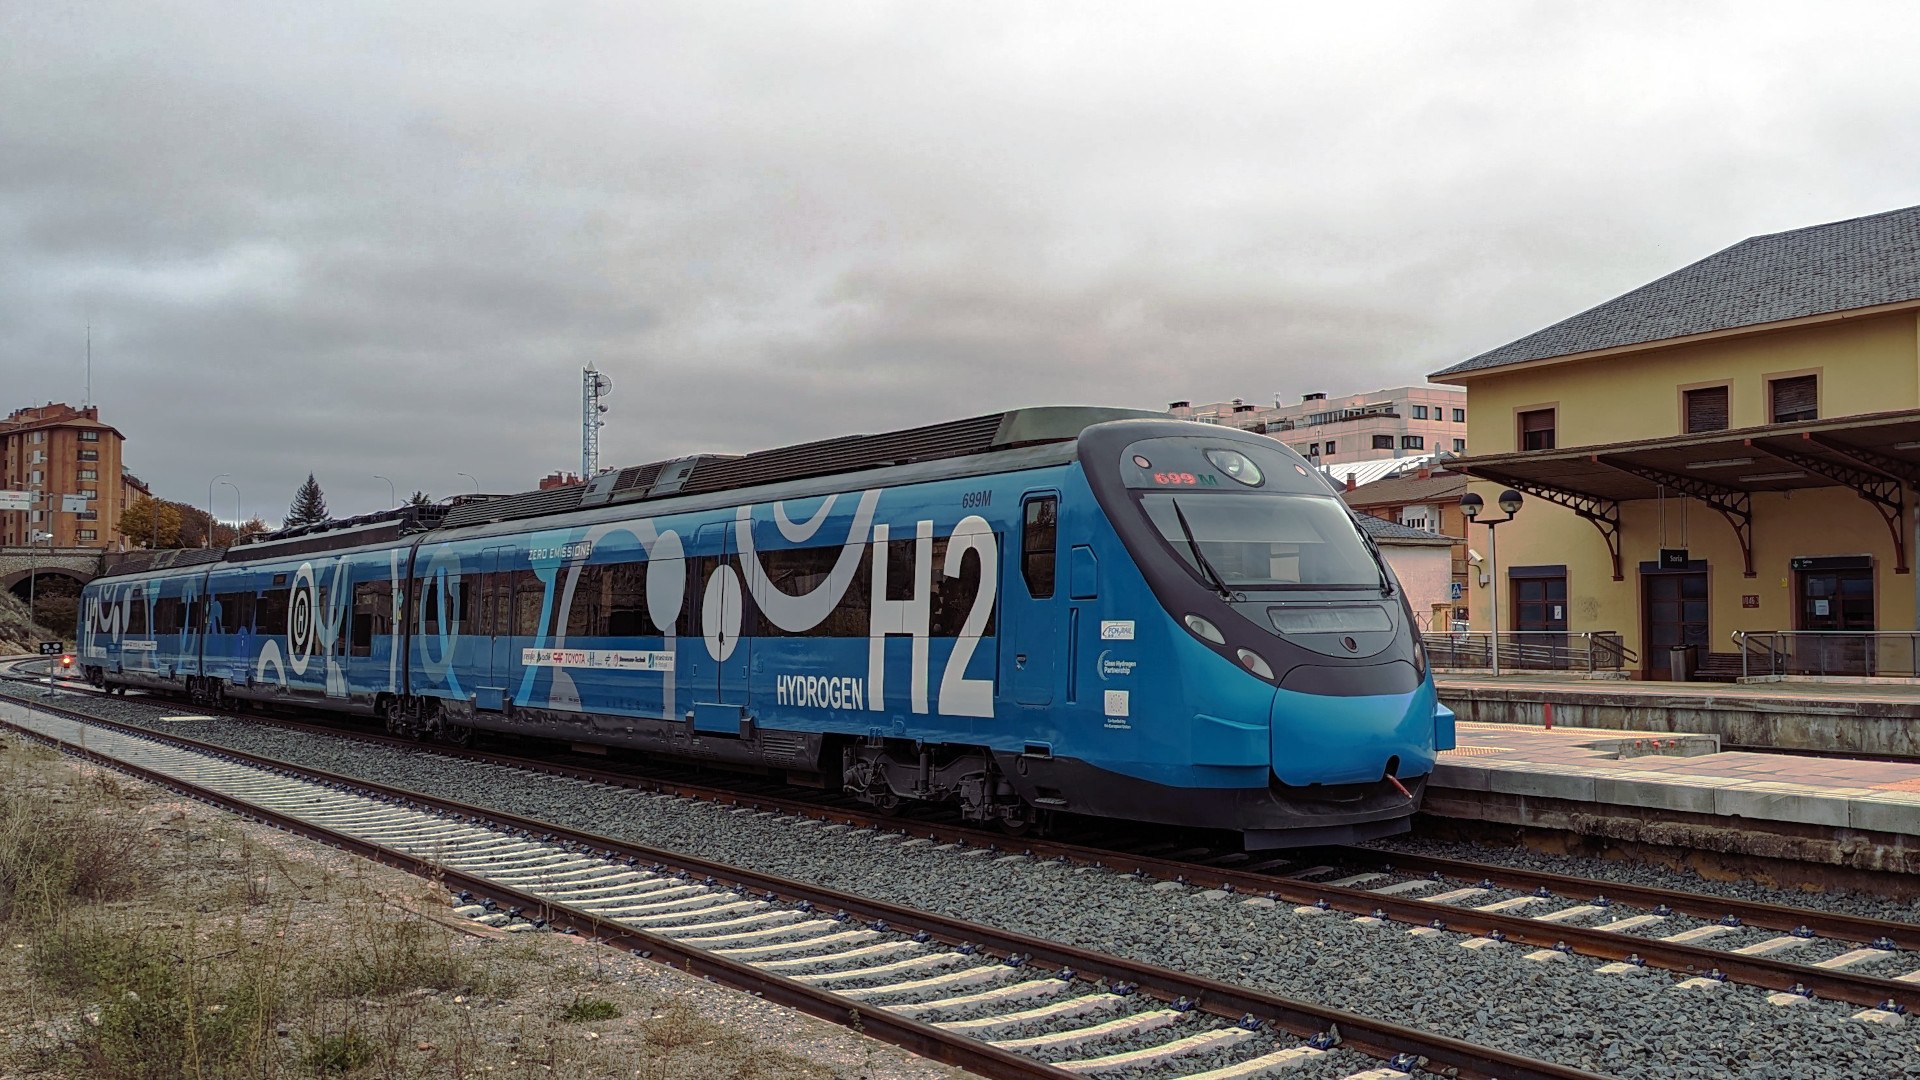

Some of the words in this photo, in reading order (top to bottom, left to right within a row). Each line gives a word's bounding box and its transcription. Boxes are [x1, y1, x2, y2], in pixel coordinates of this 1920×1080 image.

[962, 490, 992, 509] 699M
[528, 549, 548, 560] ZERO
[549, 544, 591, 559] EMISSIONS
[868, 515, 998, 718] H2
[565, 652, 585, 664] TOYOTA
[1116, 660, 1136, 668] Hydrogen
[1104, 666, 1130, 675] Partnership
[777, 674, 863, 711] HYDROGEN
